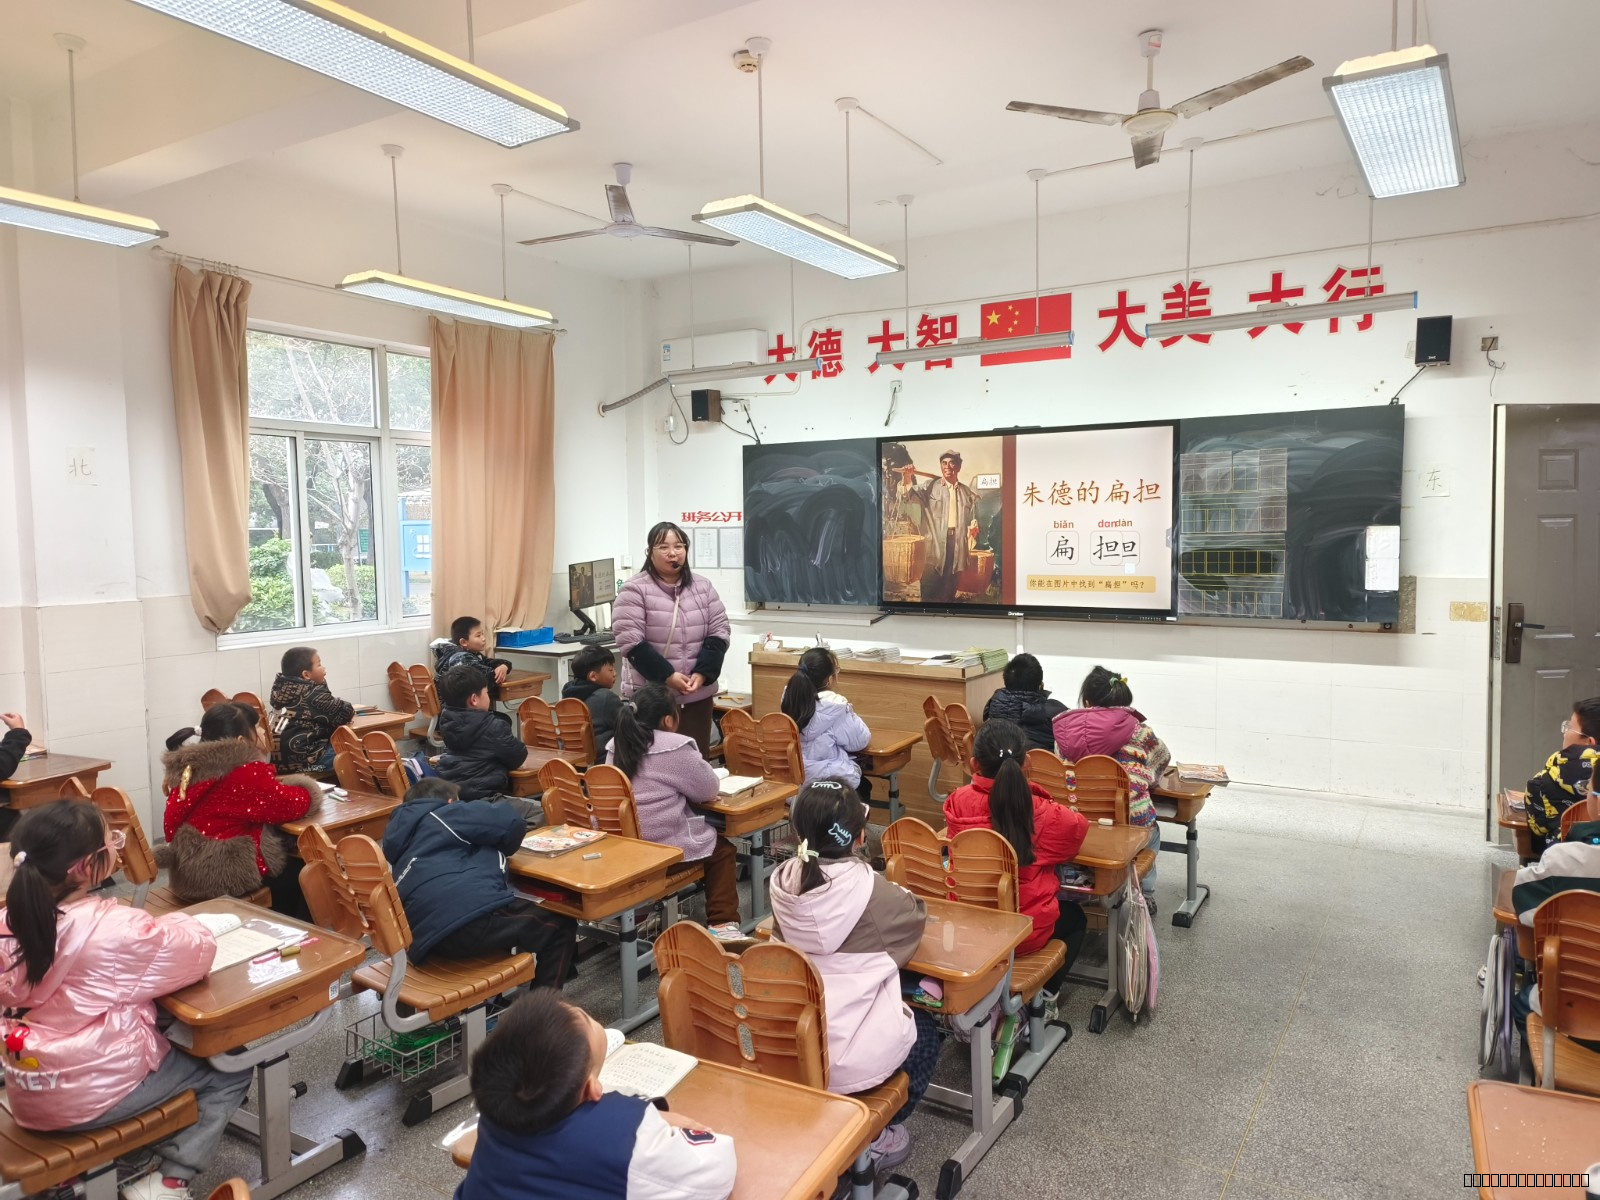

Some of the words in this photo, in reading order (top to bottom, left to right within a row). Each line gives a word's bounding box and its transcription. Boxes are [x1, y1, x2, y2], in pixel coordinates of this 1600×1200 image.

[764, 328, 842, 385] 大德
[867, 313, 958, 375] 大智
[1097, 280, 1213, 353] 大美
[1246, 265, 1385, 340] 大行
[68, 457, 93, 477] 北
[1425, 468, 1443, 491] 东
[1022, 478, 1162, 507] 朱德的扁担
[681, 510, 743, 524] 班务公开
[1049, 535, 1075, 561] 扁
